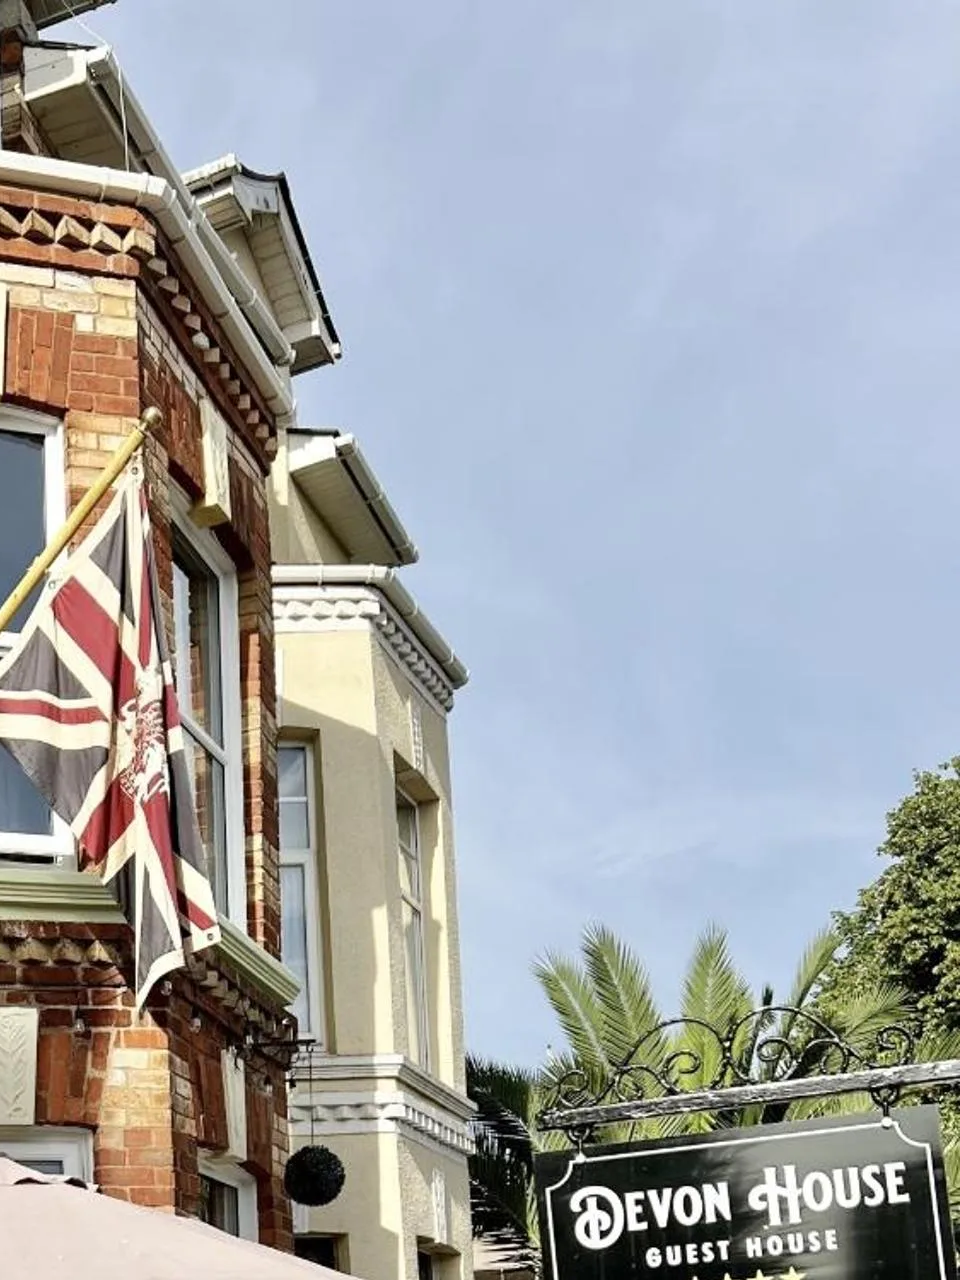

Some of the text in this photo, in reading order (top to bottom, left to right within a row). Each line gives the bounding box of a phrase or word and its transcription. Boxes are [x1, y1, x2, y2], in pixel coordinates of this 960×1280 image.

[570, 1161, 911, 1250] DEVON HOUSE
[645, 1228, 839, 1269] GUEST HOUSE
